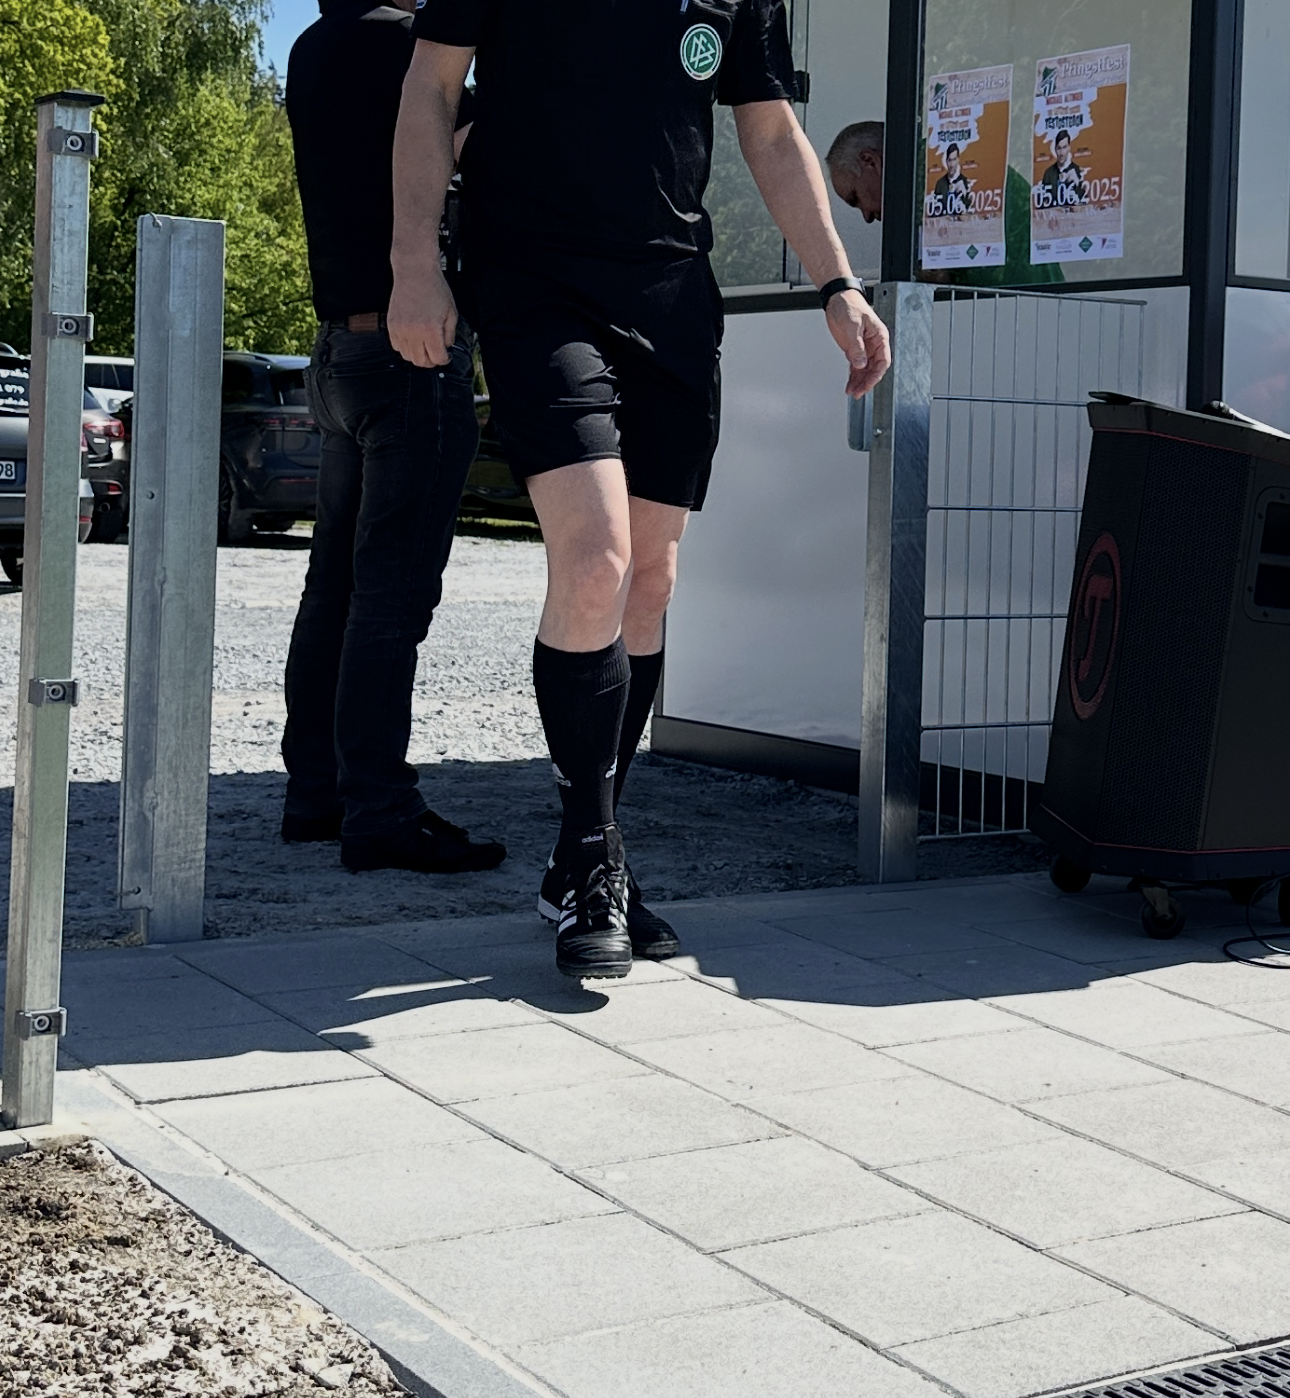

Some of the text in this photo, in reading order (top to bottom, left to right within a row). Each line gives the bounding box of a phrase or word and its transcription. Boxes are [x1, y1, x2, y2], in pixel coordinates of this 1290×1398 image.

[1061, 55, 1127, 79] Pfingstfest
[952, 75, 1009, 96] Pfingstfest
[926, 189, 1002, 217] 05.06.2025
[1034, 177, 1120, 209] 05.06.2025
